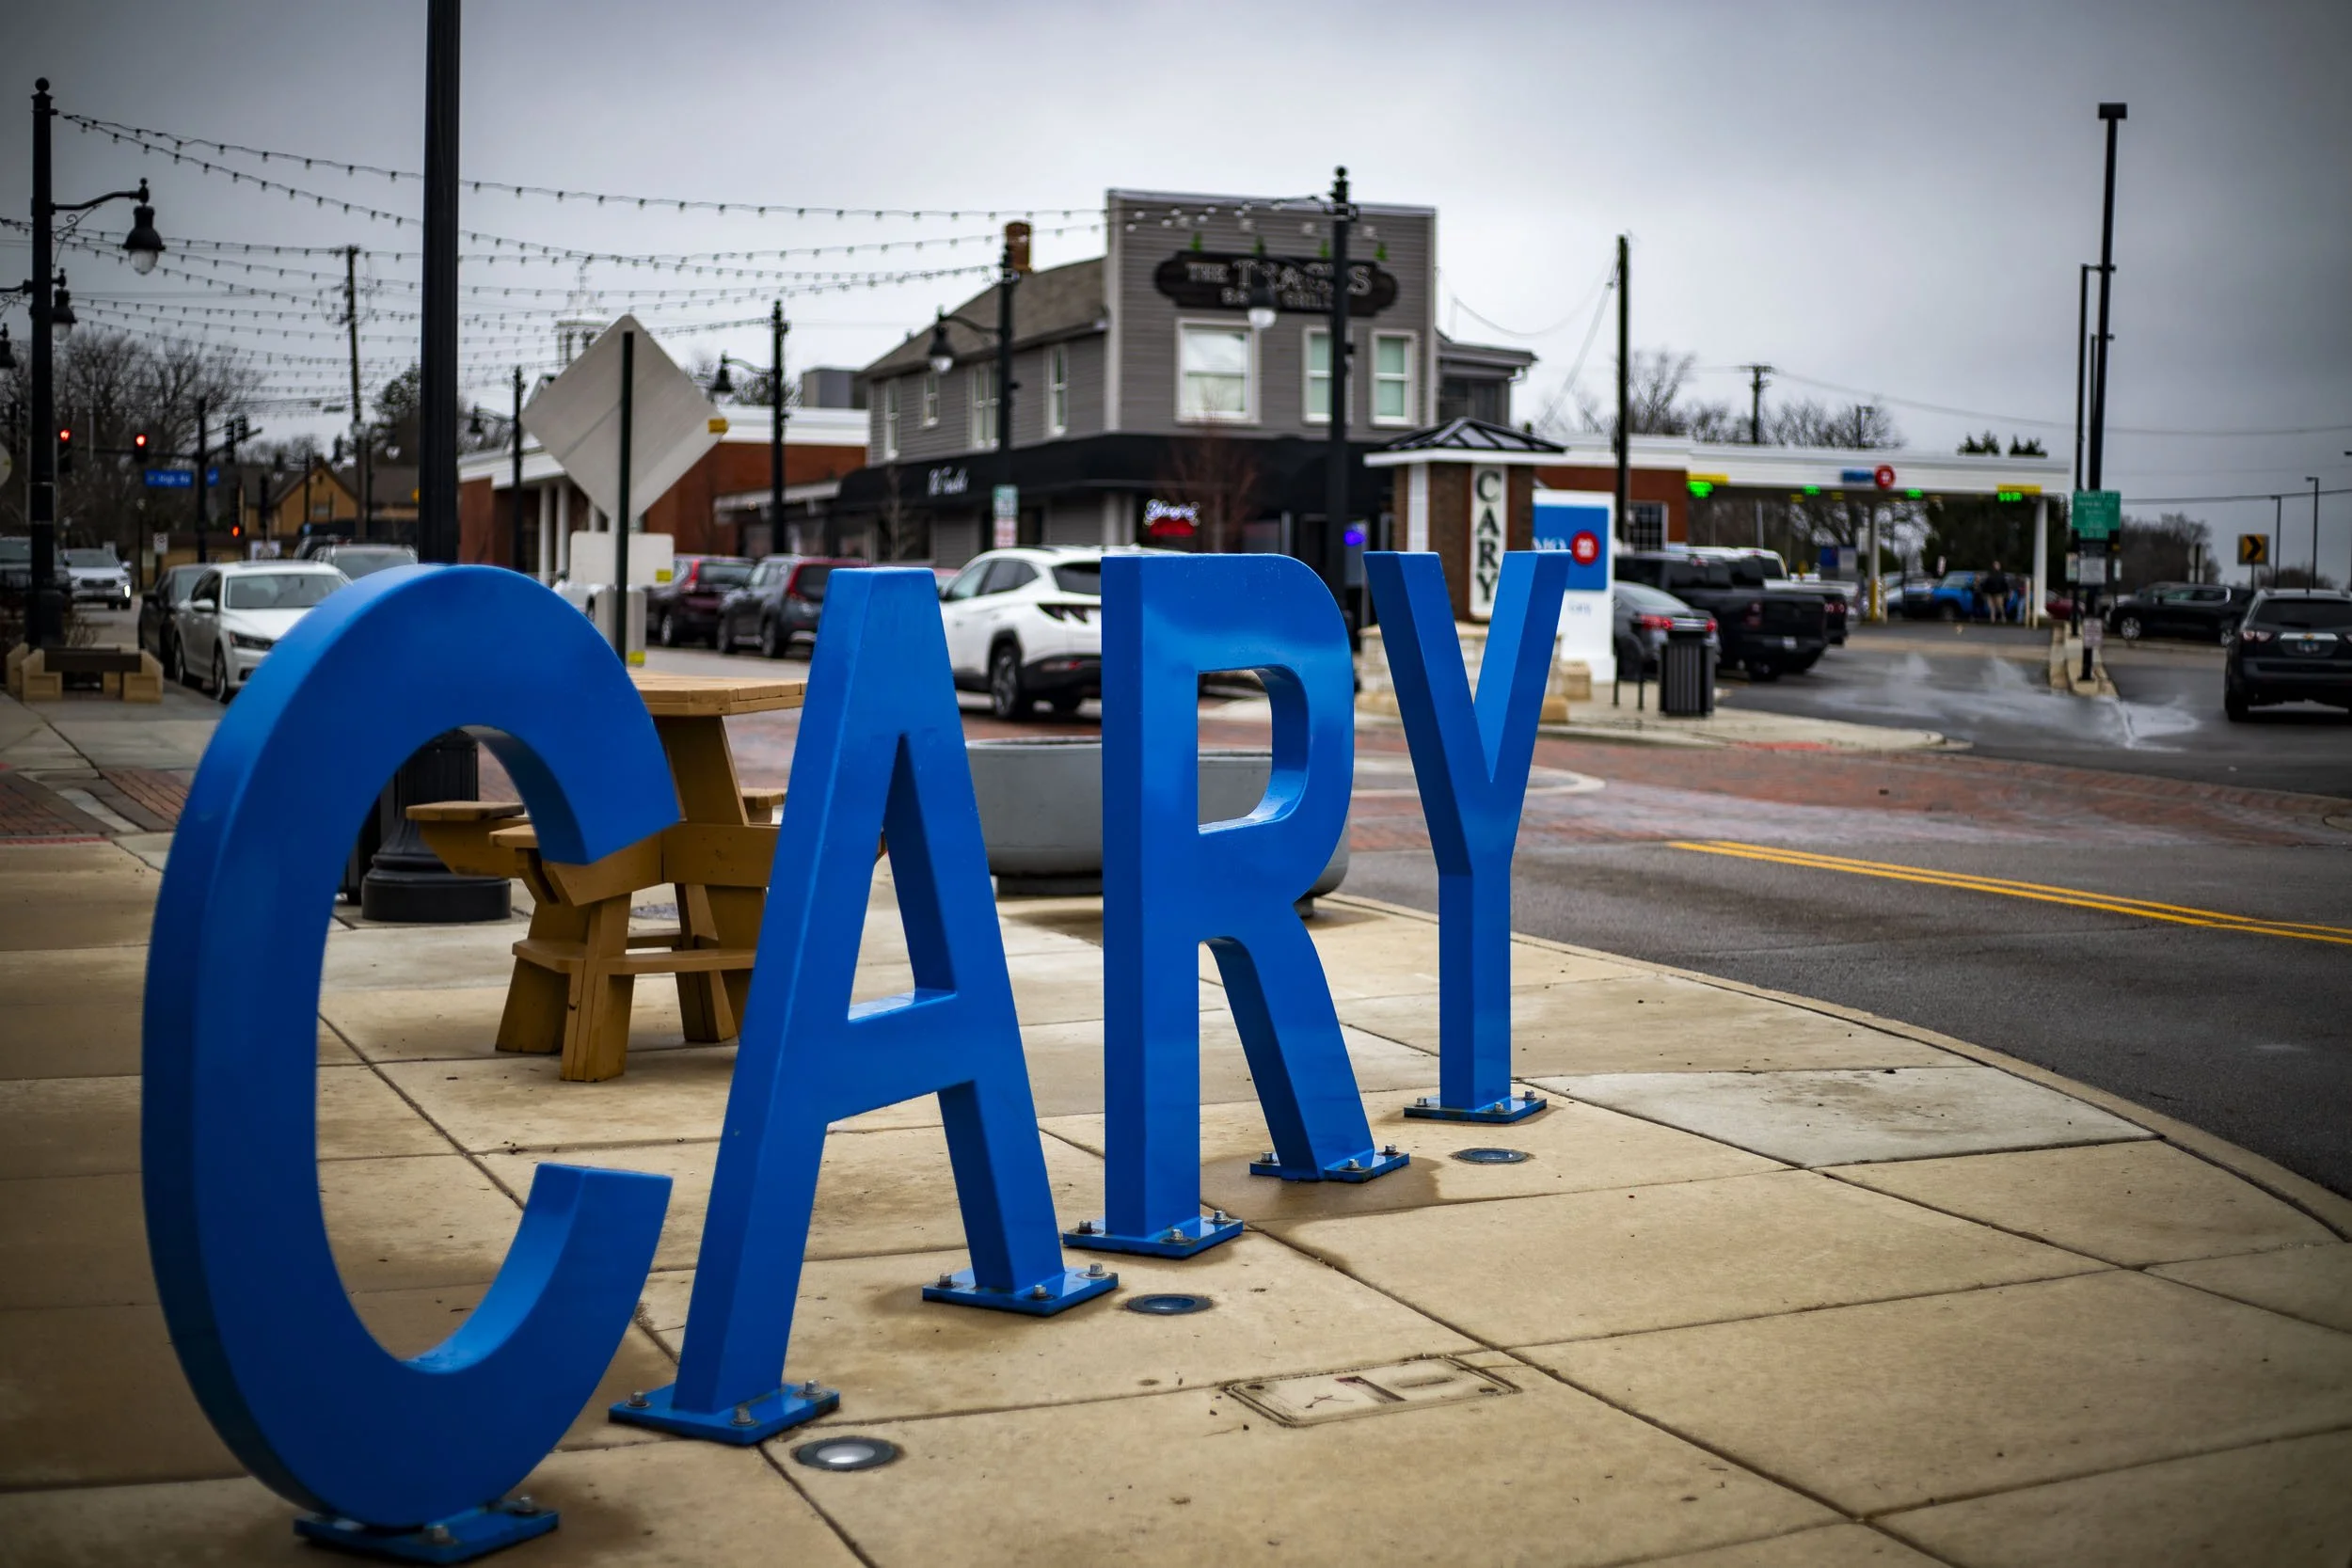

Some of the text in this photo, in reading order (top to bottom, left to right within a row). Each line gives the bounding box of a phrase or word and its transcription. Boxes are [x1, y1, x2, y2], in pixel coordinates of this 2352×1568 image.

[1185, 262, 1229, 283] THE
[1476, 469, 1502, 602] CARY
[143, 550, 1571, 1533] CARY
